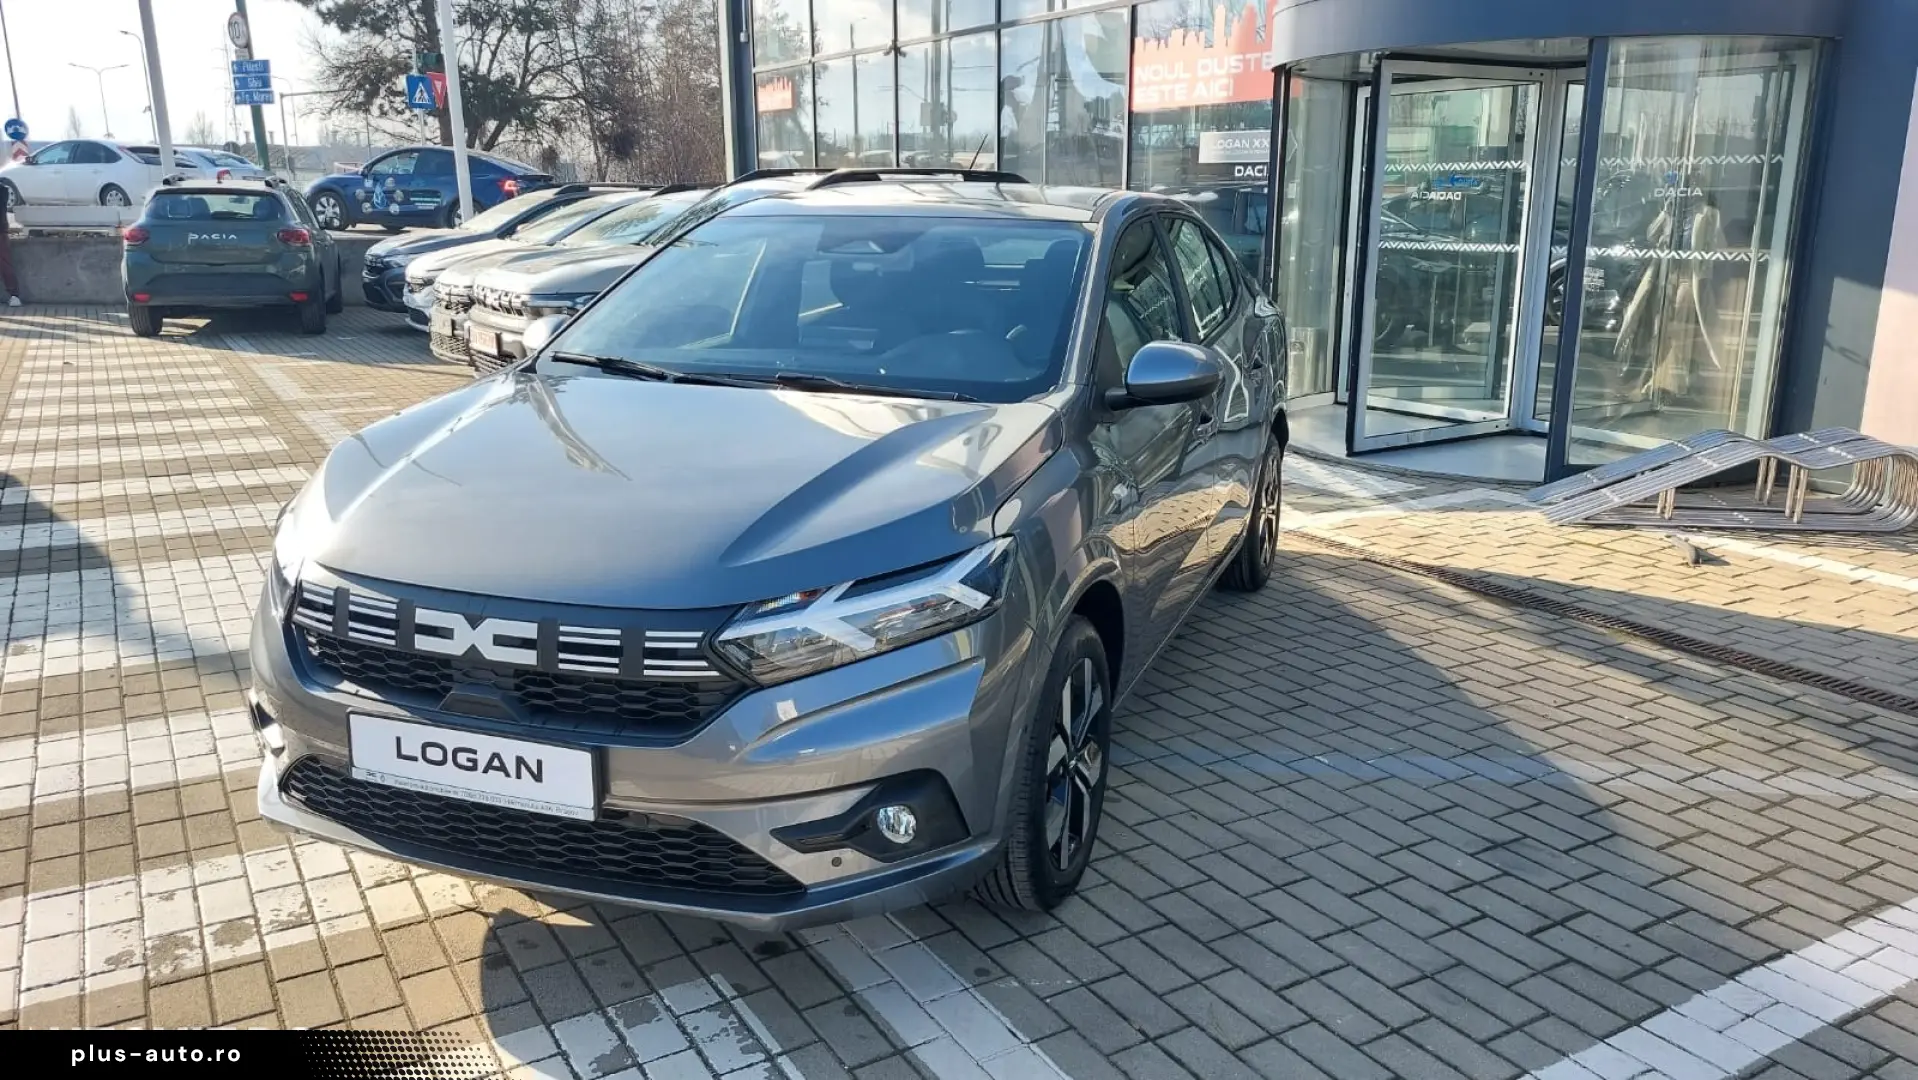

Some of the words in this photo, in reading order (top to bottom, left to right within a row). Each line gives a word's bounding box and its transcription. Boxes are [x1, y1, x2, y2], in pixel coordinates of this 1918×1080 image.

[1137, 63, 1191, 82] NOUL
[1136, 84, 1187, 102] ESTE
[1193, 78, 1233, 98] AICI
[1235, 165, 1269, 177] DACI
[1654, 187, 1703, 197] DACIA
[396, 736, 543, 783] LOGAN
